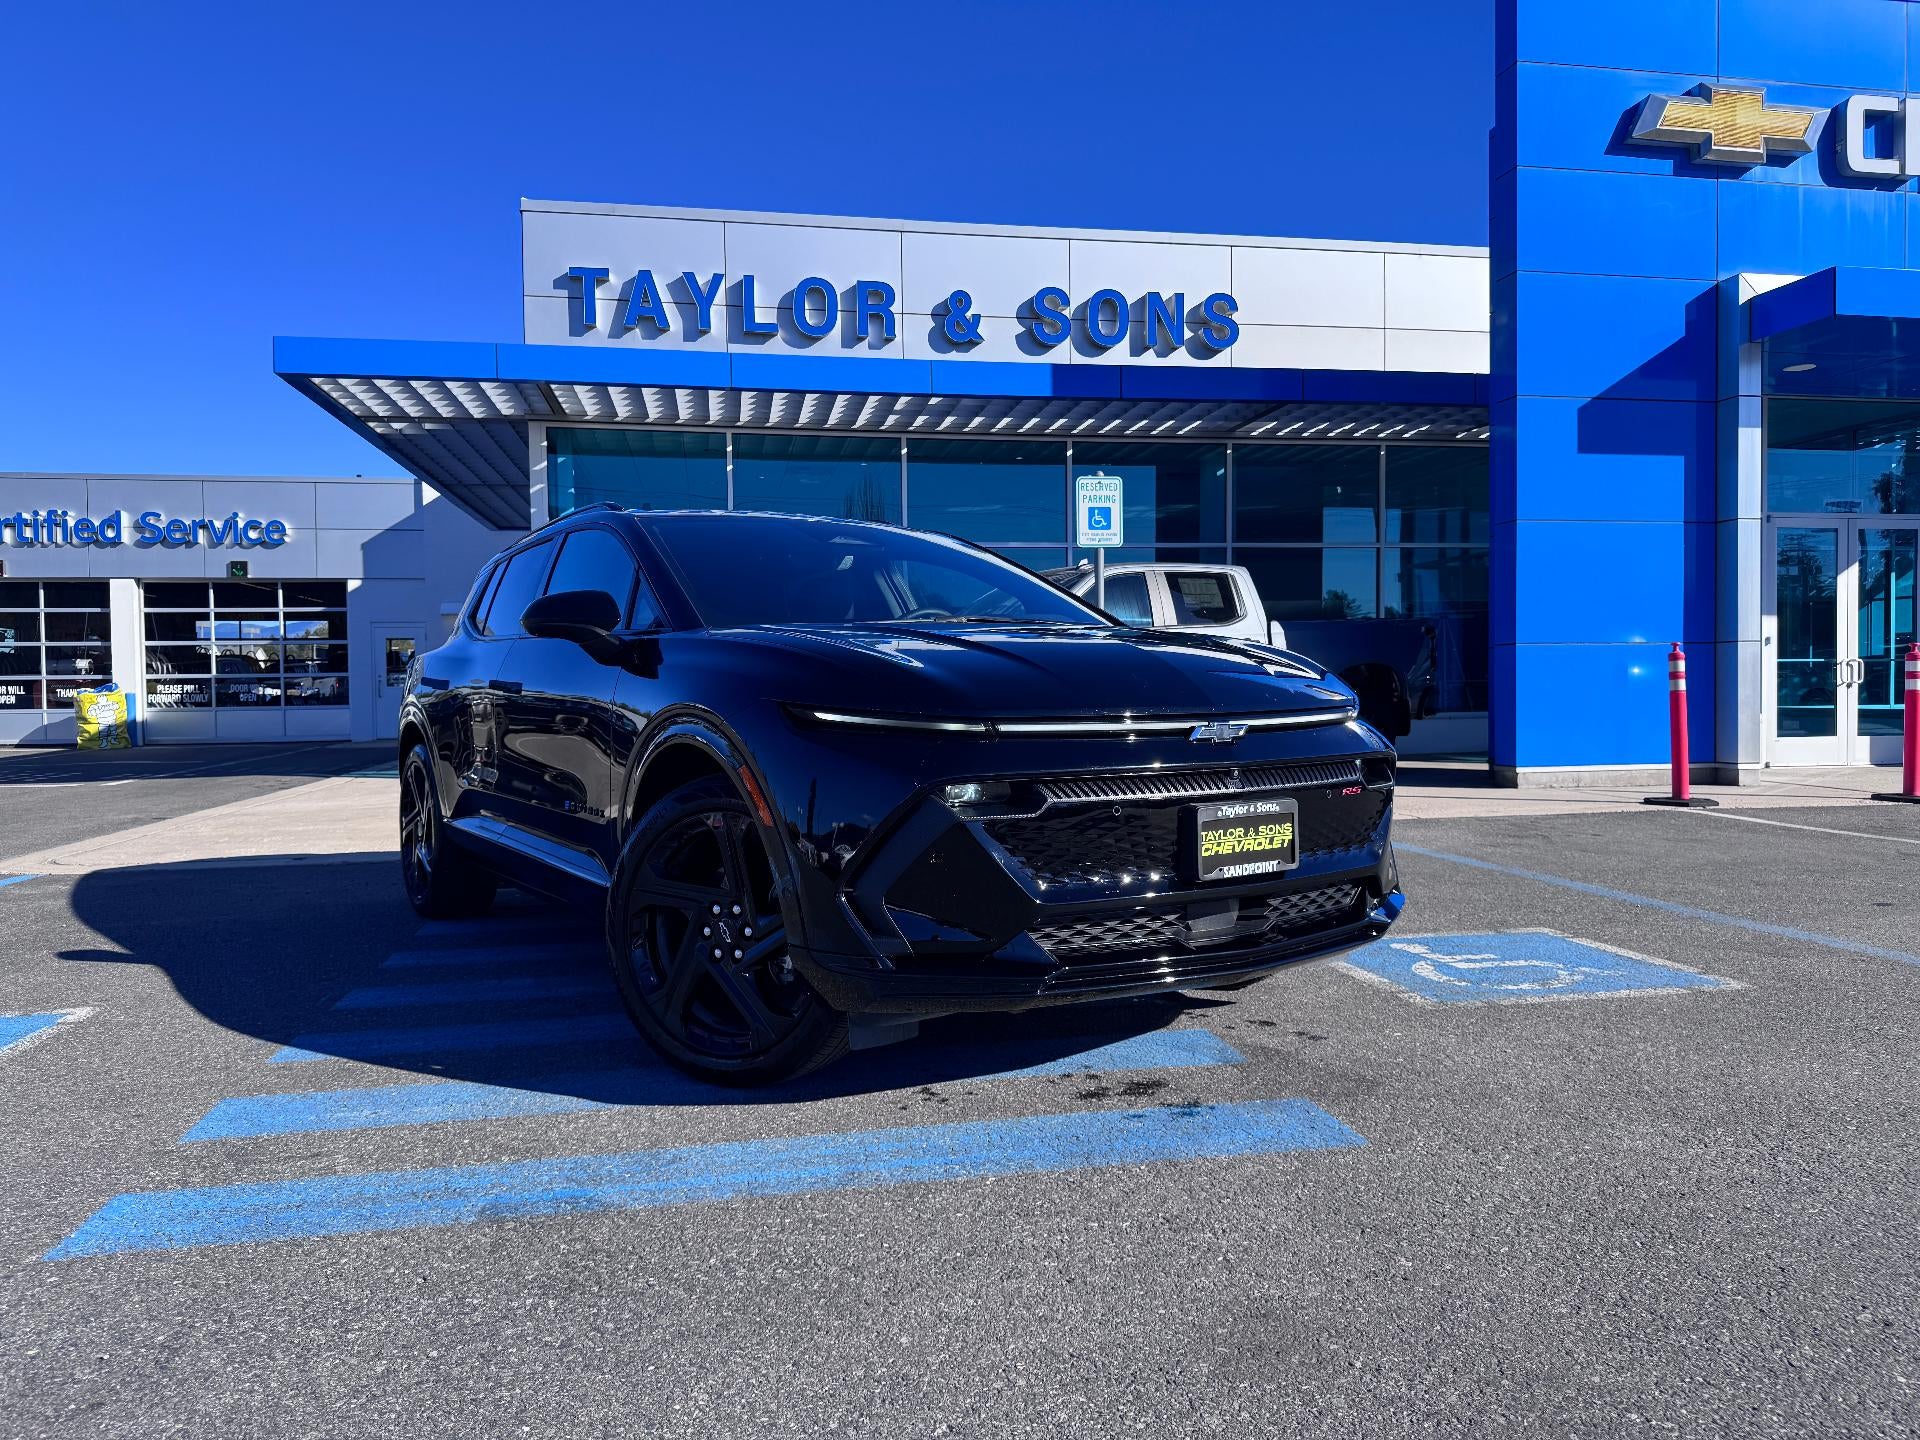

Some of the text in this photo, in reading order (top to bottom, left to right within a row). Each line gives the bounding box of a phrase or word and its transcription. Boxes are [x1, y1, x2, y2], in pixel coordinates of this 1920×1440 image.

[568, 266, 1239, 349] TAYLOR & SONS
[1080, 482, 1118, 491] RESERVED
[1082, 495, 1116, 503] PARKING
[139, 511, 287, 544] Service
[8, 685, 25, 694] WILL
[157, 685, 200, 693] PLEASE PULL
[230, 684, 248, 692] DOOR
[148, 694, 208, 703] FORWARD SLOWLY
[1343, 786, 1361, 795] RS
[1222, 804, 1248, 818] Taylor
[1257, 802, 1276, 813] Sons
[1201, 823, 1293, 842] TAYLOR & SONS
[1202, 834, 1293, 857] CHEVROLET
[1223, 861, 1279, 878] SANDPOINT
